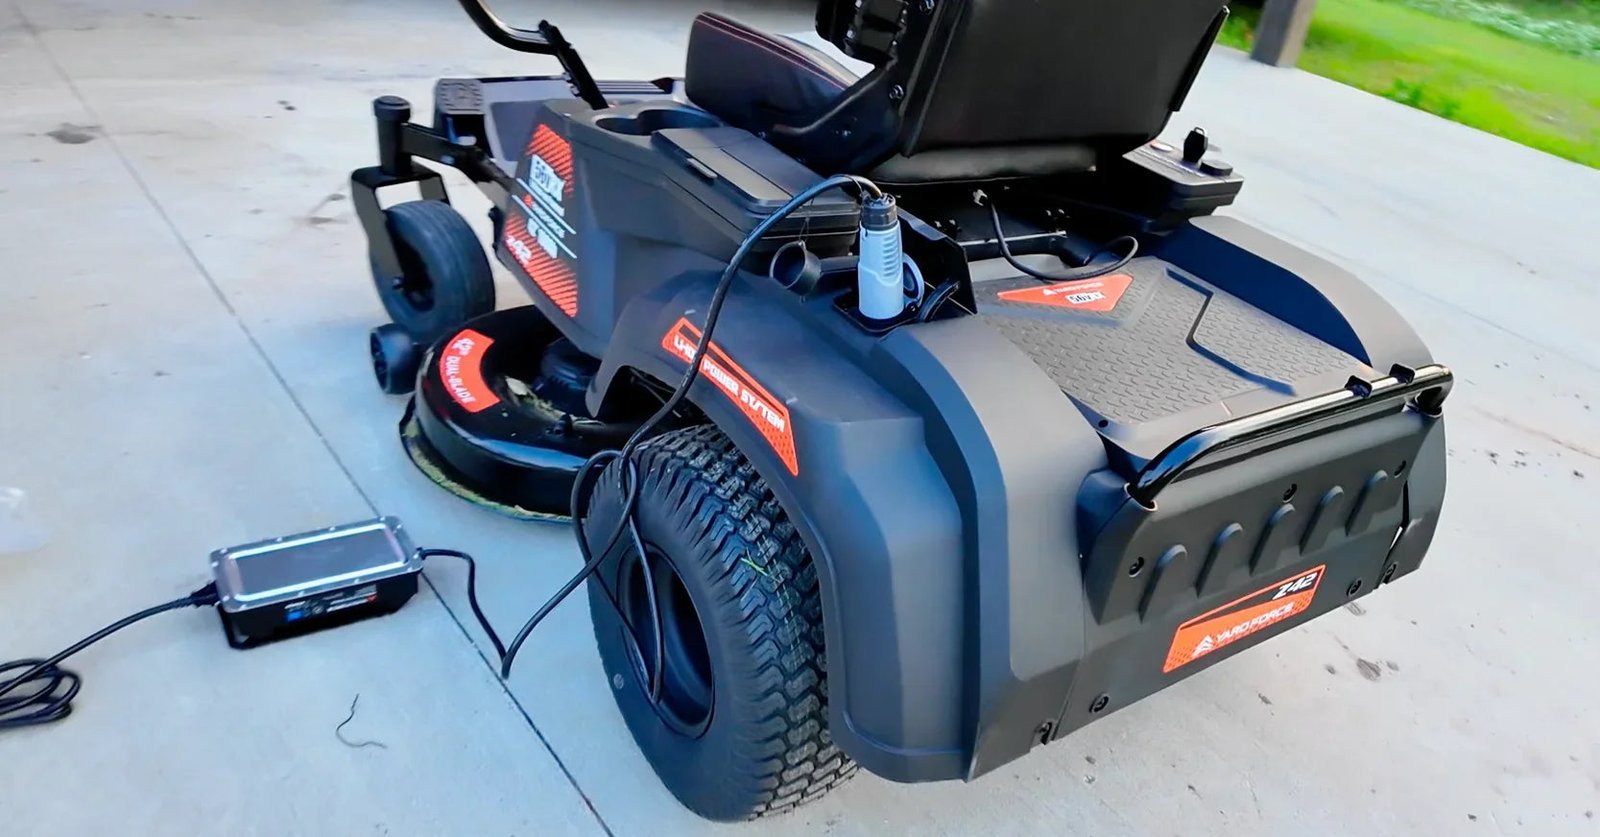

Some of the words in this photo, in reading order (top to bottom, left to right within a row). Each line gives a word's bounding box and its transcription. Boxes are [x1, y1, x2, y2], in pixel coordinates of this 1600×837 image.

[703, 358, 739, 397] POWER
[741, 388, 785, 433] SYSTEM
[1272, 572, 1318, 600] Z42
